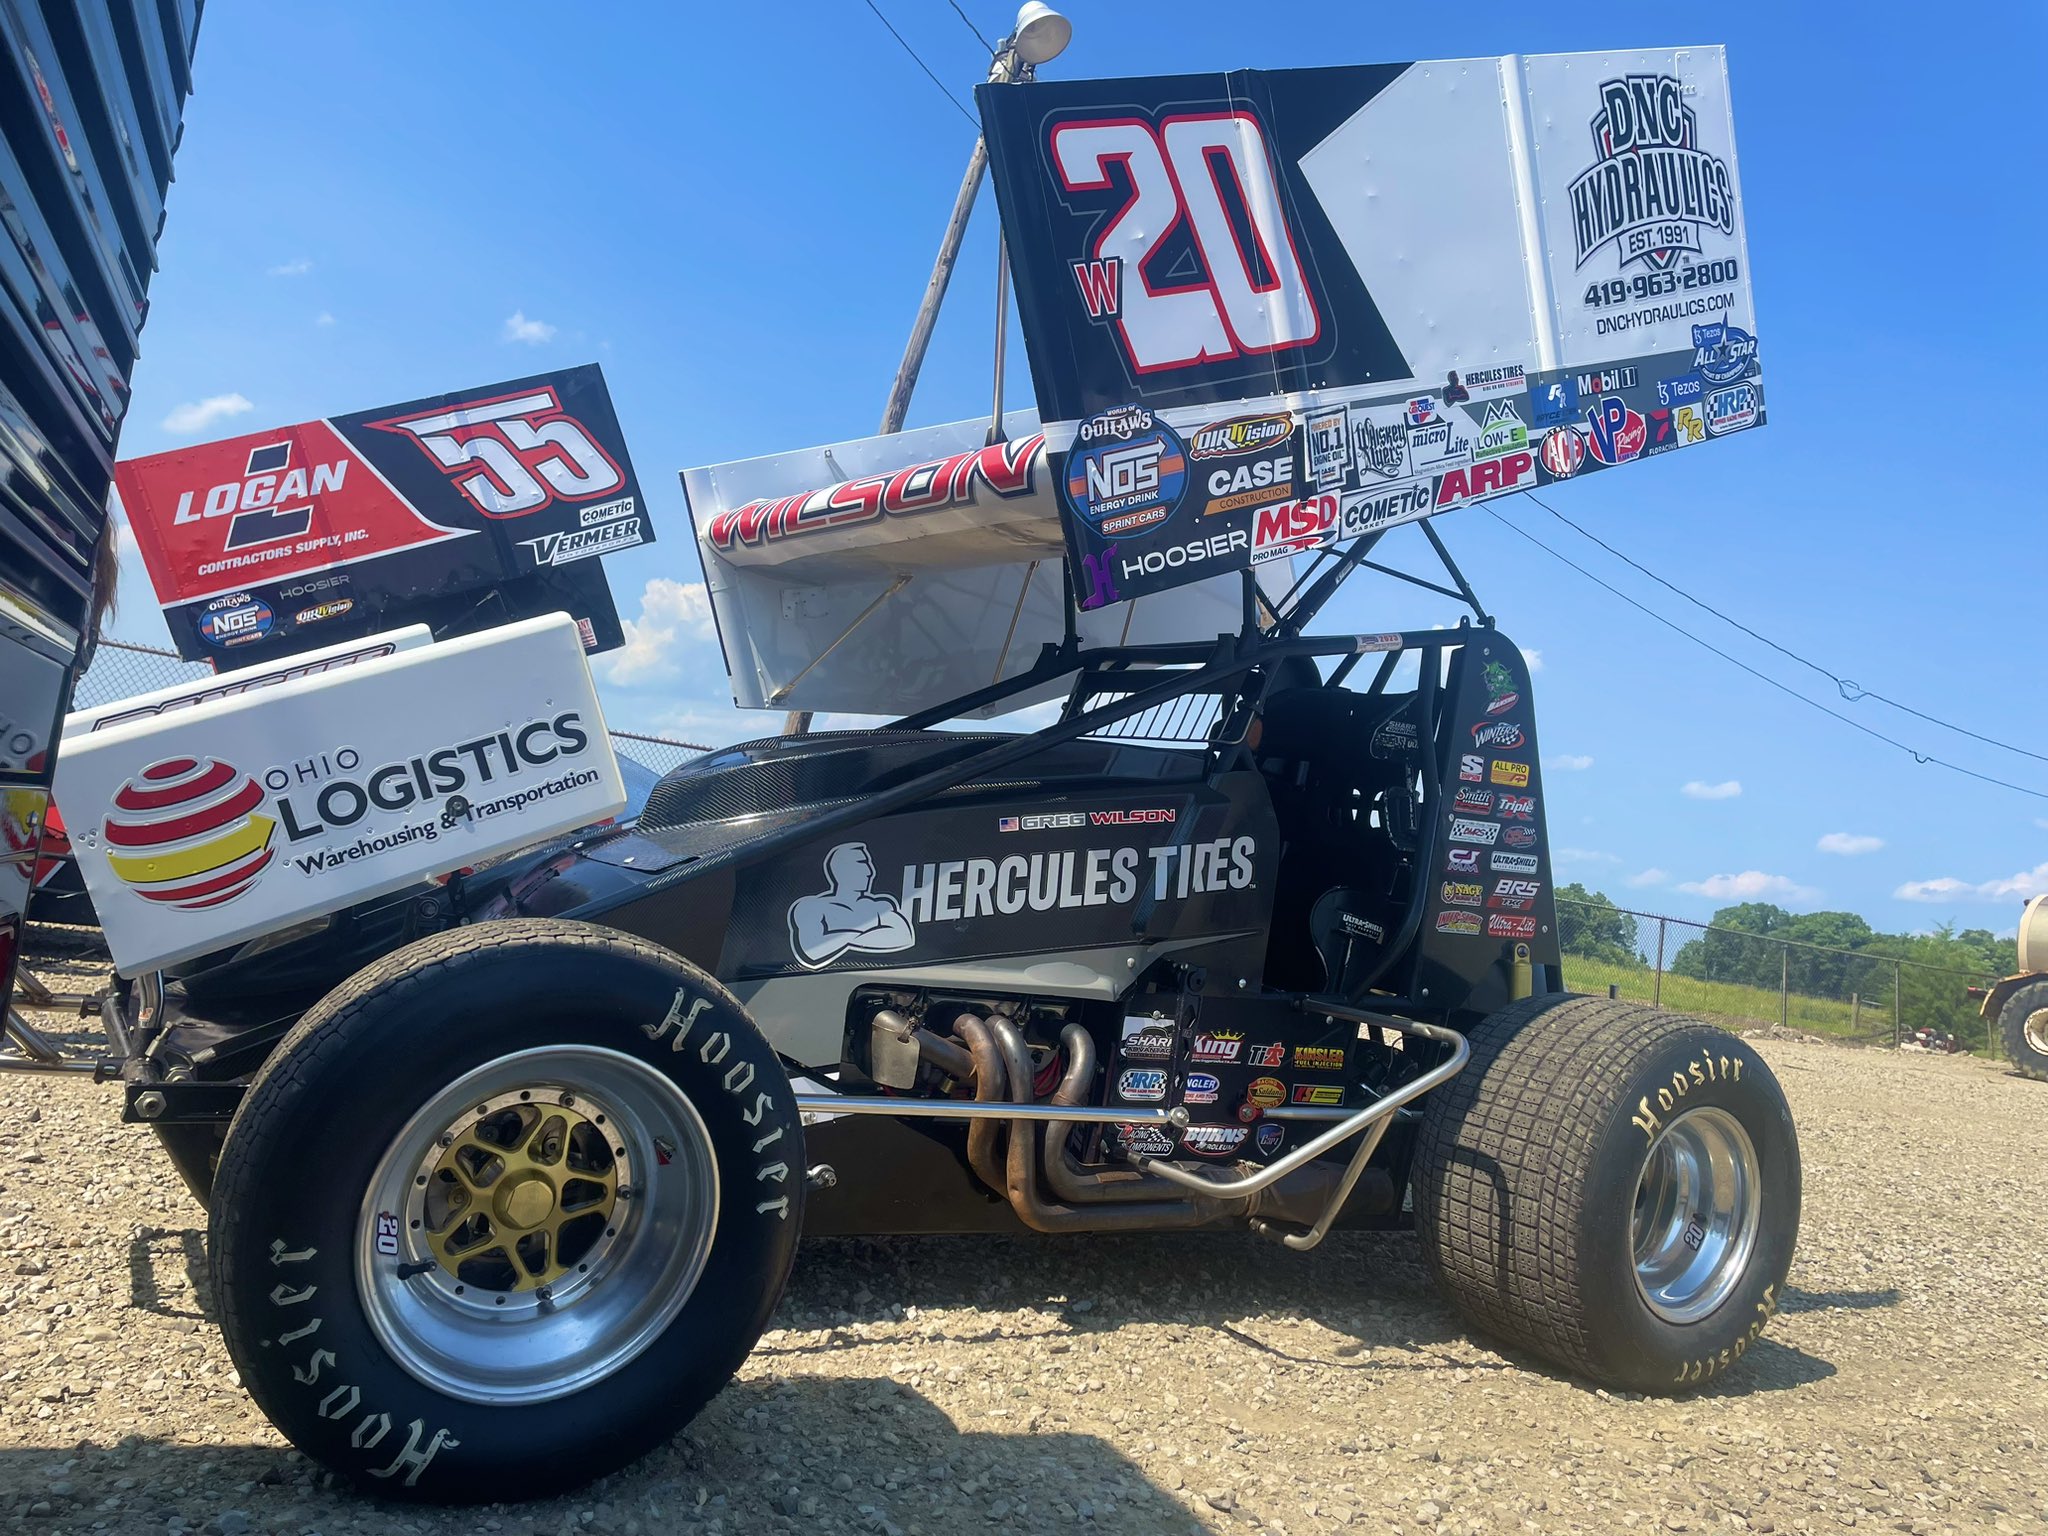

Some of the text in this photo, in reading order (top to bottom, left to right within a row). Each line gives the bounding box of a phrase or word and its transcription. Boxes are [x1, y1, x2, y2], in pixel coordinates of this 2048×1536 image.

[1602, 79, 1682, 151] DNC
[1572, 151, 1733, 250] HYDRAULICS
[1051, 110, 1321, 375] 20
[1629, 224, 1689, 252] EST. 1991
[1072, 259, 1118, 317] W
[1596, 292, 1736, 336] DNCHYDRAULICS.COM
[1702, 327, 1722, 340] Tezos
[1694, 340, 1756, 367] ALL STAR
[1465, 364, 1524, 386] HERCULES TIRES
[1577, 369, 1620, 396] Mobil
[1671, 380, 1701, 397] Tezos
[1106, 404, 1136, 416] WORLD OF
[1716, 387, 1748, 418] HRP
[1081, 410, 1152, 441] OUTLAWS
[1585, 396, 1627, 463] VP
[1617, 425, 1644, 454] Racing
[387, 388, 624, 517] 55
[1311, 427, 1343, 456] NO.1
[1649, 441, 1678, 456] FLORACING
[1085, 439, 1167, 502] NOS
[1207, 456, 1294, 496] CASE
[1437, 452, 1533, 506] ARP
[173, 459, 349, 526] LOGAN
[709, 434, 1044, 551] WILSON
[1089, 491, 1159, 516] ENERGY DRINK
[1219, 486, 1290, 510] CONSTRUCTION
[581, 500, 633, 522] COMETIC
[1102, 508, 1166, 534] SPRINT CARS
[1255, 495, 1338, 546] MSD
[1344, 487, 1430, 529] COMETIC
[532, 519, 639, 563] VERMEER
[1351, 521, 1386, 533] GASKET
[197, 529, 369, 576] CONTRACTORS SUPPLY, INC.
[1121, 529, 1249, 580] HOOSIER
[1252, 546, 1289, 563] PRO MAG
[279, 574, 350, 601] HOOSIER
[212, 605, 260, 635] NOS
[265, 748, 359, 791] OHIO
[276, 712, 588, 842] LOGISTICS
[1494, 761, 1527, 774] ALL PRO
[1456, 786, 1493, 804] Smith
[1499, 798, 1534, 814] Triple
[1021, 808, 1176, 830] GREG WILSON
[295, 819, 437, 875] Warehousing
[903, 835, 1257, 924] HERCULES TIRES
[1455, 883, 1483, 898] NAGY
[1494, 879, 1541, 897] BRS
[1294, 1047, 1344, 1063] KINSLER
[1130, 1071, 1161, 1090] HRP
[641, 986, 792, 1220] Hoosier
[1631, 1048, 1744, 1148] Hoosier
[1123, 1125, 1150, 1139] RACING
[1185, 1126, 1248, 1143] BURNS
[375, 1211, 400, 1257] 20
[1683, 1222, 1706, 1252] 20
[266, 1238, 462, 1488] Hoosier
